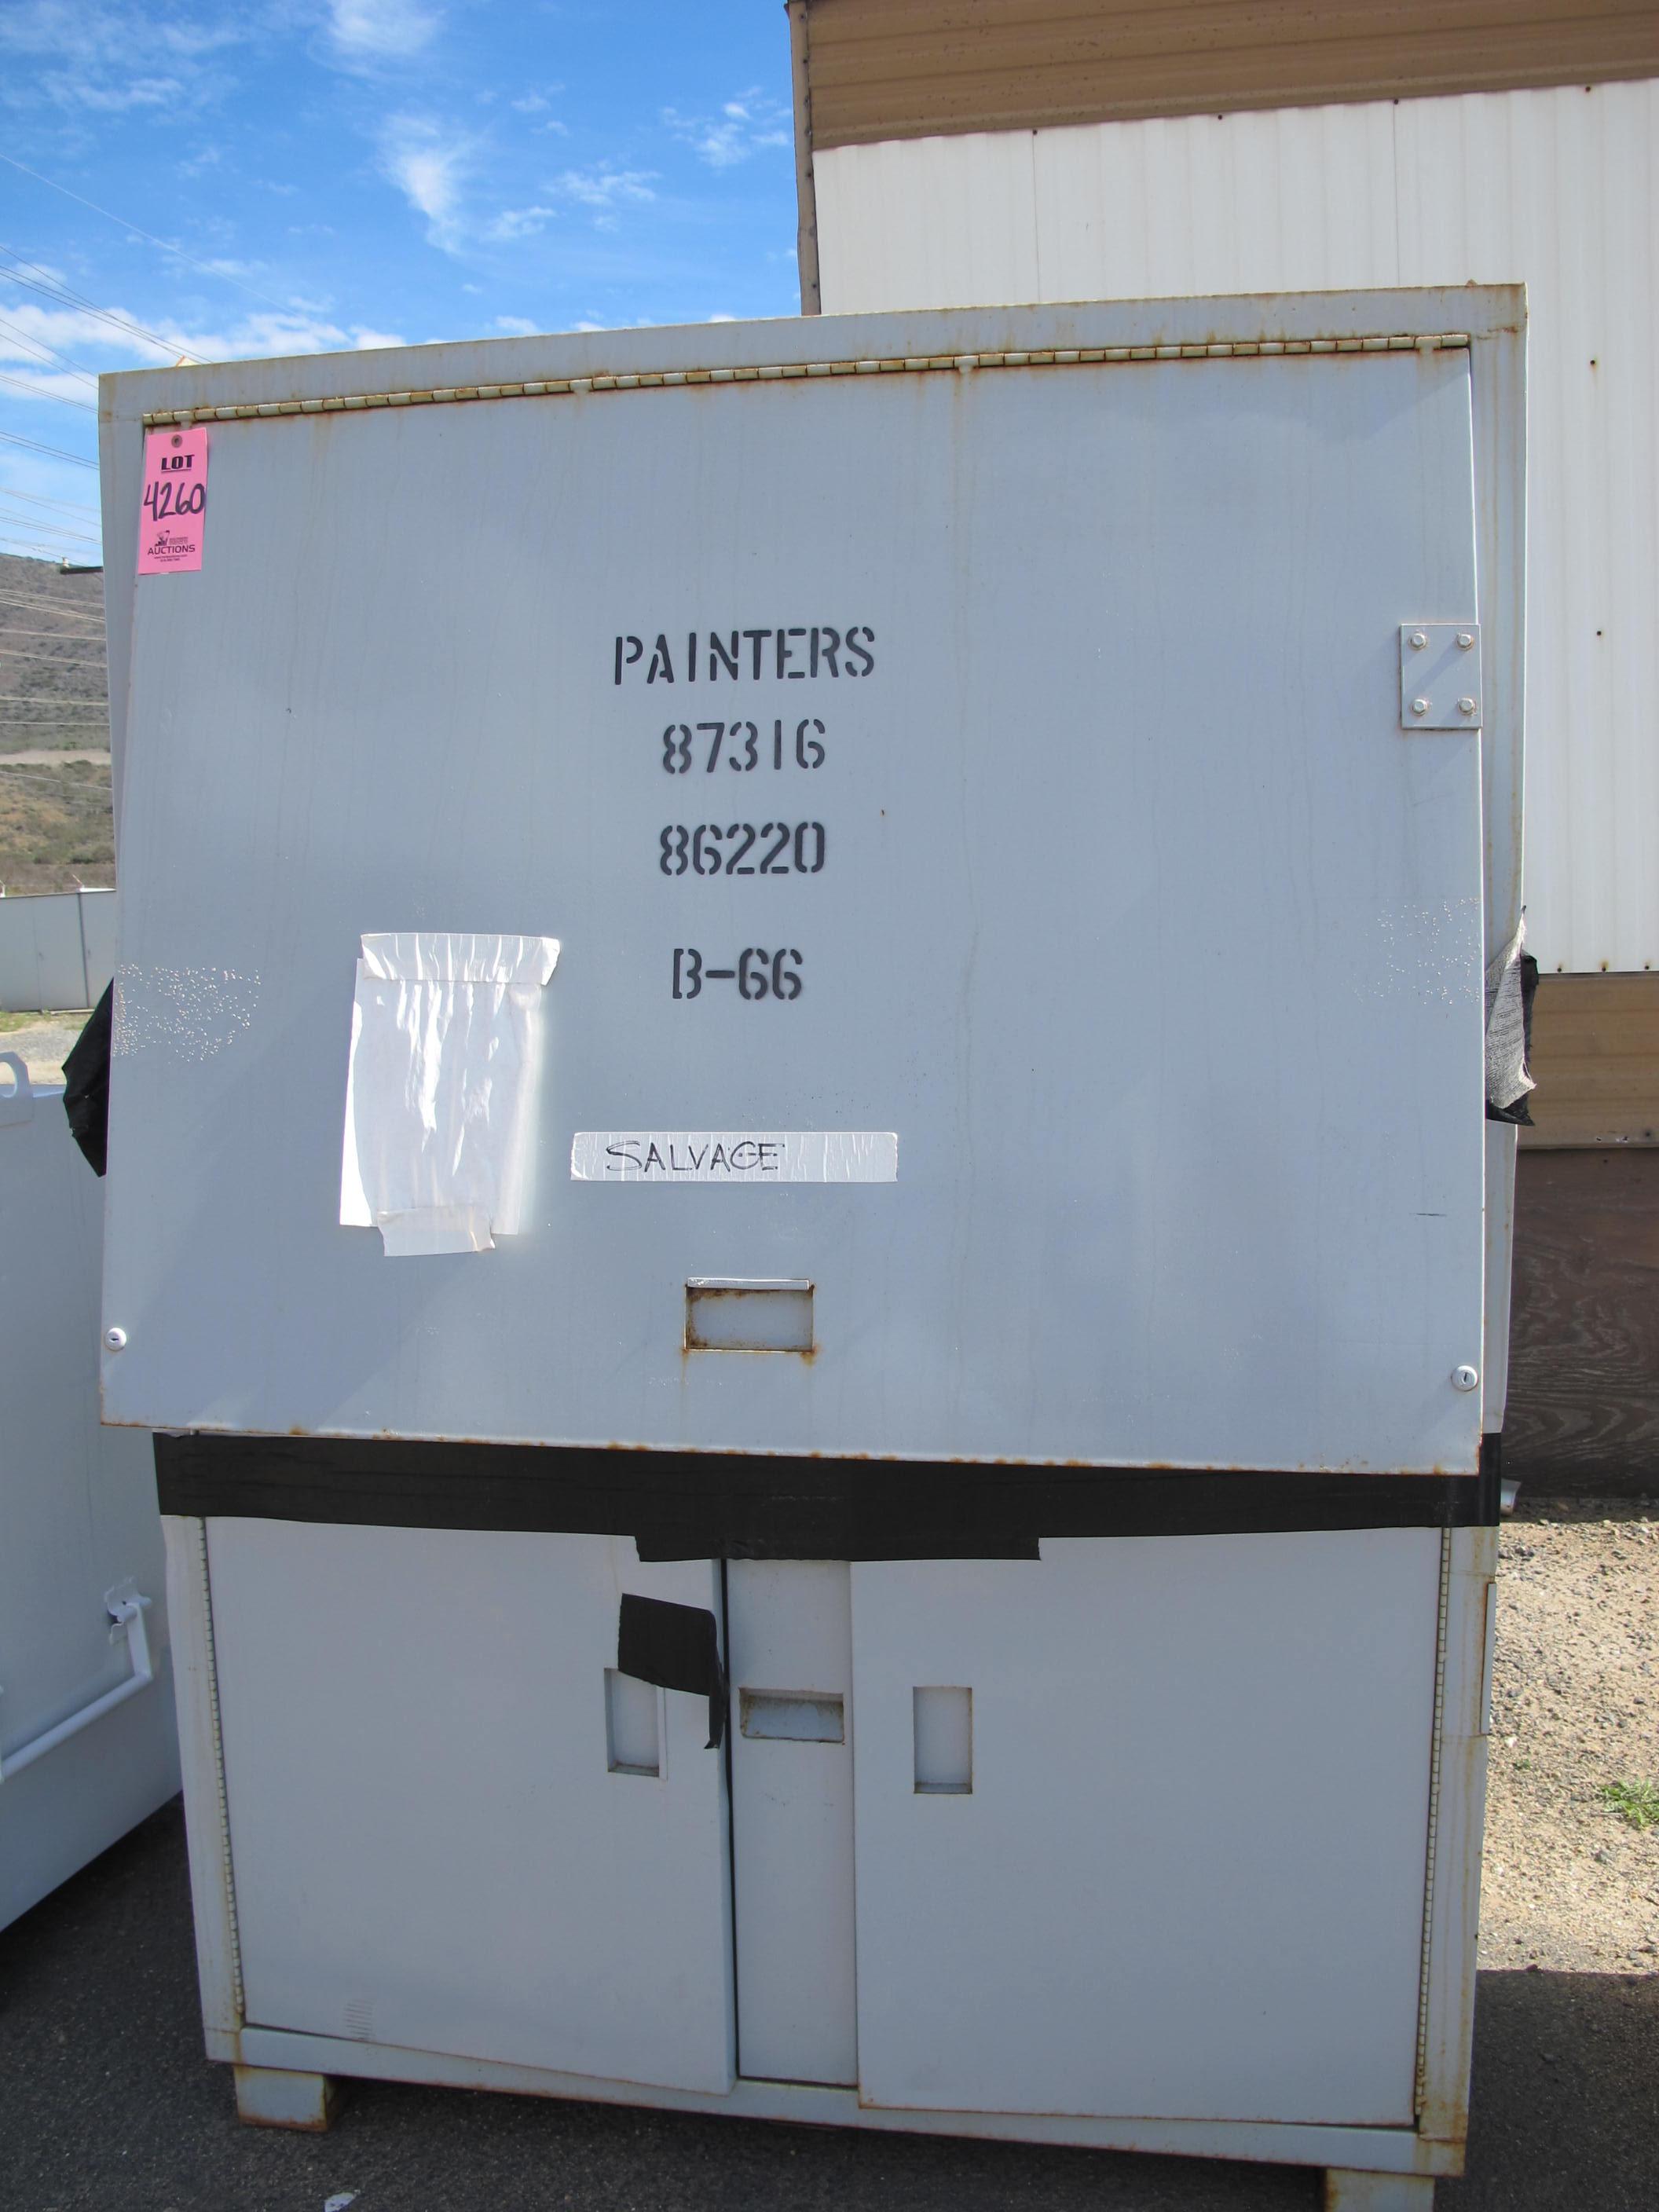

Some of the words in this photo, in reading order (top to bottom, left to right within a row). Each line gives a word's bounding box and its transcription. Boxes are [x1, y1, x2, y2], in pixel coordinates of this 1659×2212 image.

[161, 454, 195, 471] LOT
[144, 481, 206, 522] 4260
[148, 544, 196, 555] AUCTIONS
[614, 627, 875, 685] PAINTERS
[662, 719, 826, 774] 87316
[660, 822, 826, 875] 86220
[672, 948, 803, 1000] B-66
[606, 1141, 786, 1172] SALVAGE
